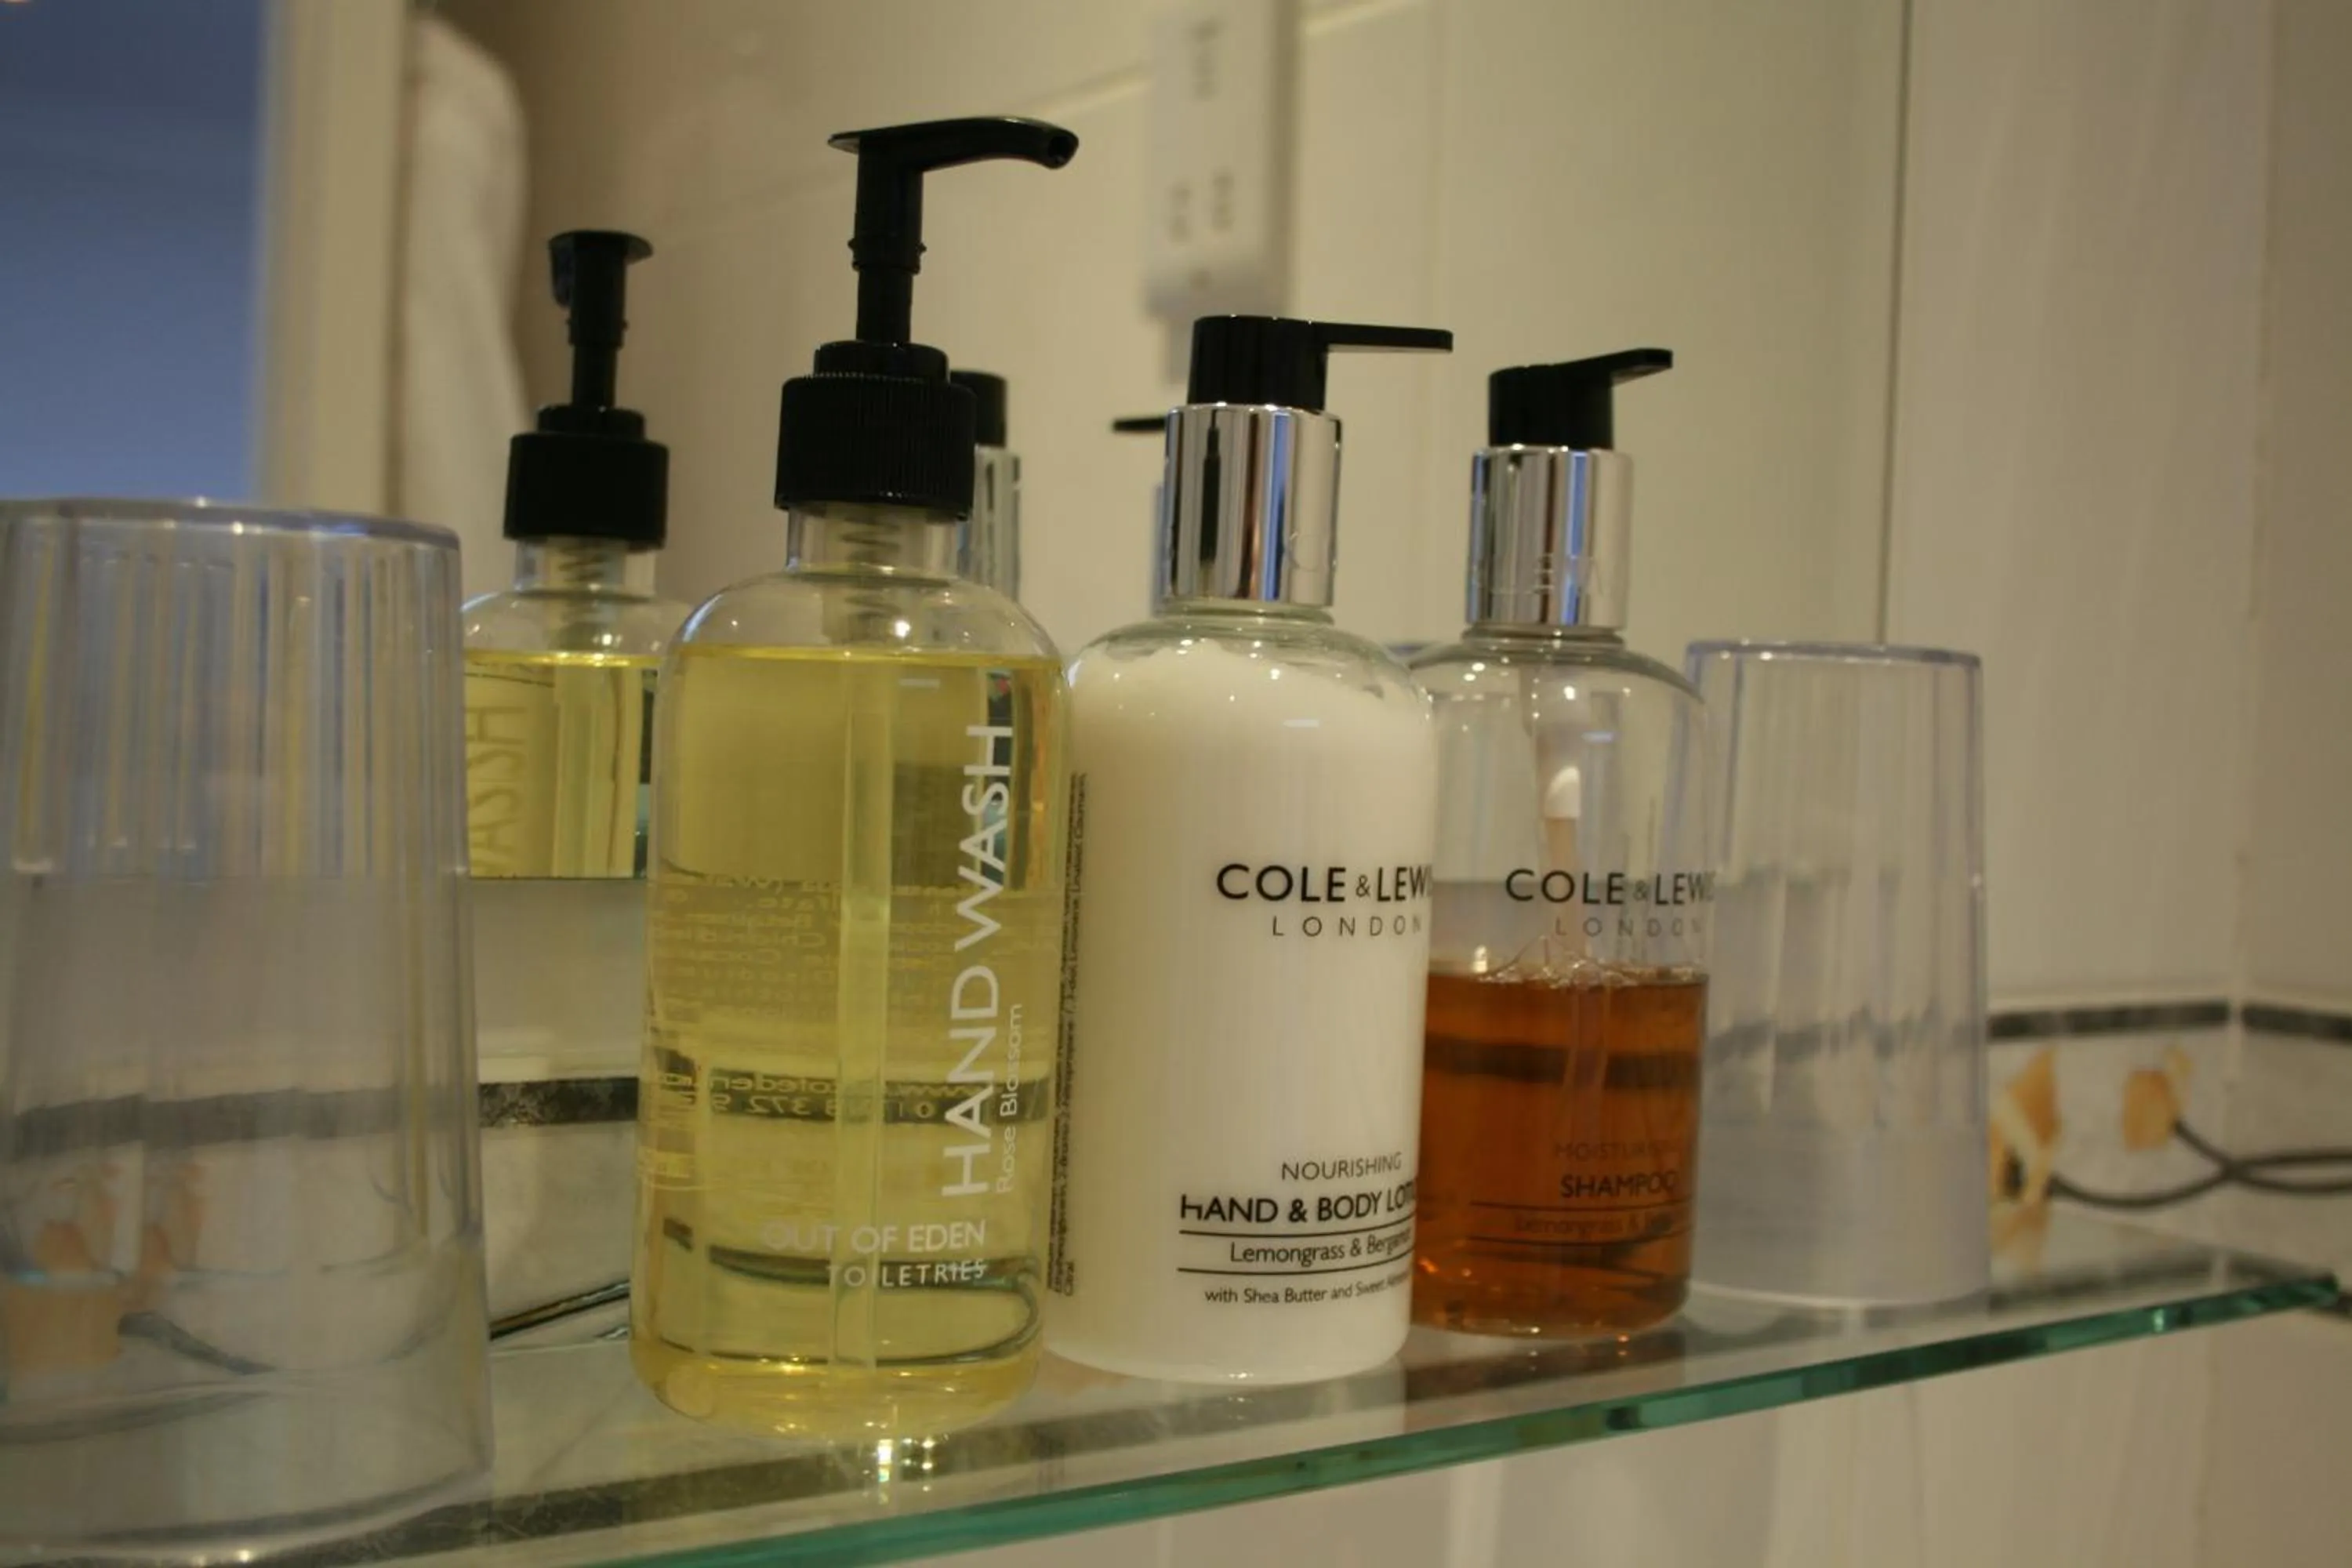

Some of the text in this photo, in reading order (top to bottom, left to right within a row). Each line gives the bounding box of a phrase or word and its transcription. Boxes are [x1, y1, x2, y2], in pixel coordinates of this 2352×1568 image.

[1217, 863, 1432, 902] COLE & LEW
[1505, 869, 1715, 905] COLE & LEW
[1272, 916, 1421, 937] LONDON
[1555, 916, 1701, 937] LONDON
[942, 724, 1014, 1196] HAND WASH
[995, 1003, 1024, 1193] Rose Blossom
[1281, 1151, 1403, 1181] NOURISHING
[1179, 1181, 1414, 1223] HAND & BODY LOT
[760, 1219, 986, 1254] OUT OF EDEN
[1230, 1241, 1345, 1268] Lemongrass
[1350, 1238, 1362, 1257] &
[827, 1258, 988, 1288] TOILETRIES
[1203, 1287, 1239, 1304] with
[1243, 1287, 1279, 1304] Shea
[1284, 1287, 1328, 1304] Butter
[1330, 1283, 1353, 1300] and
